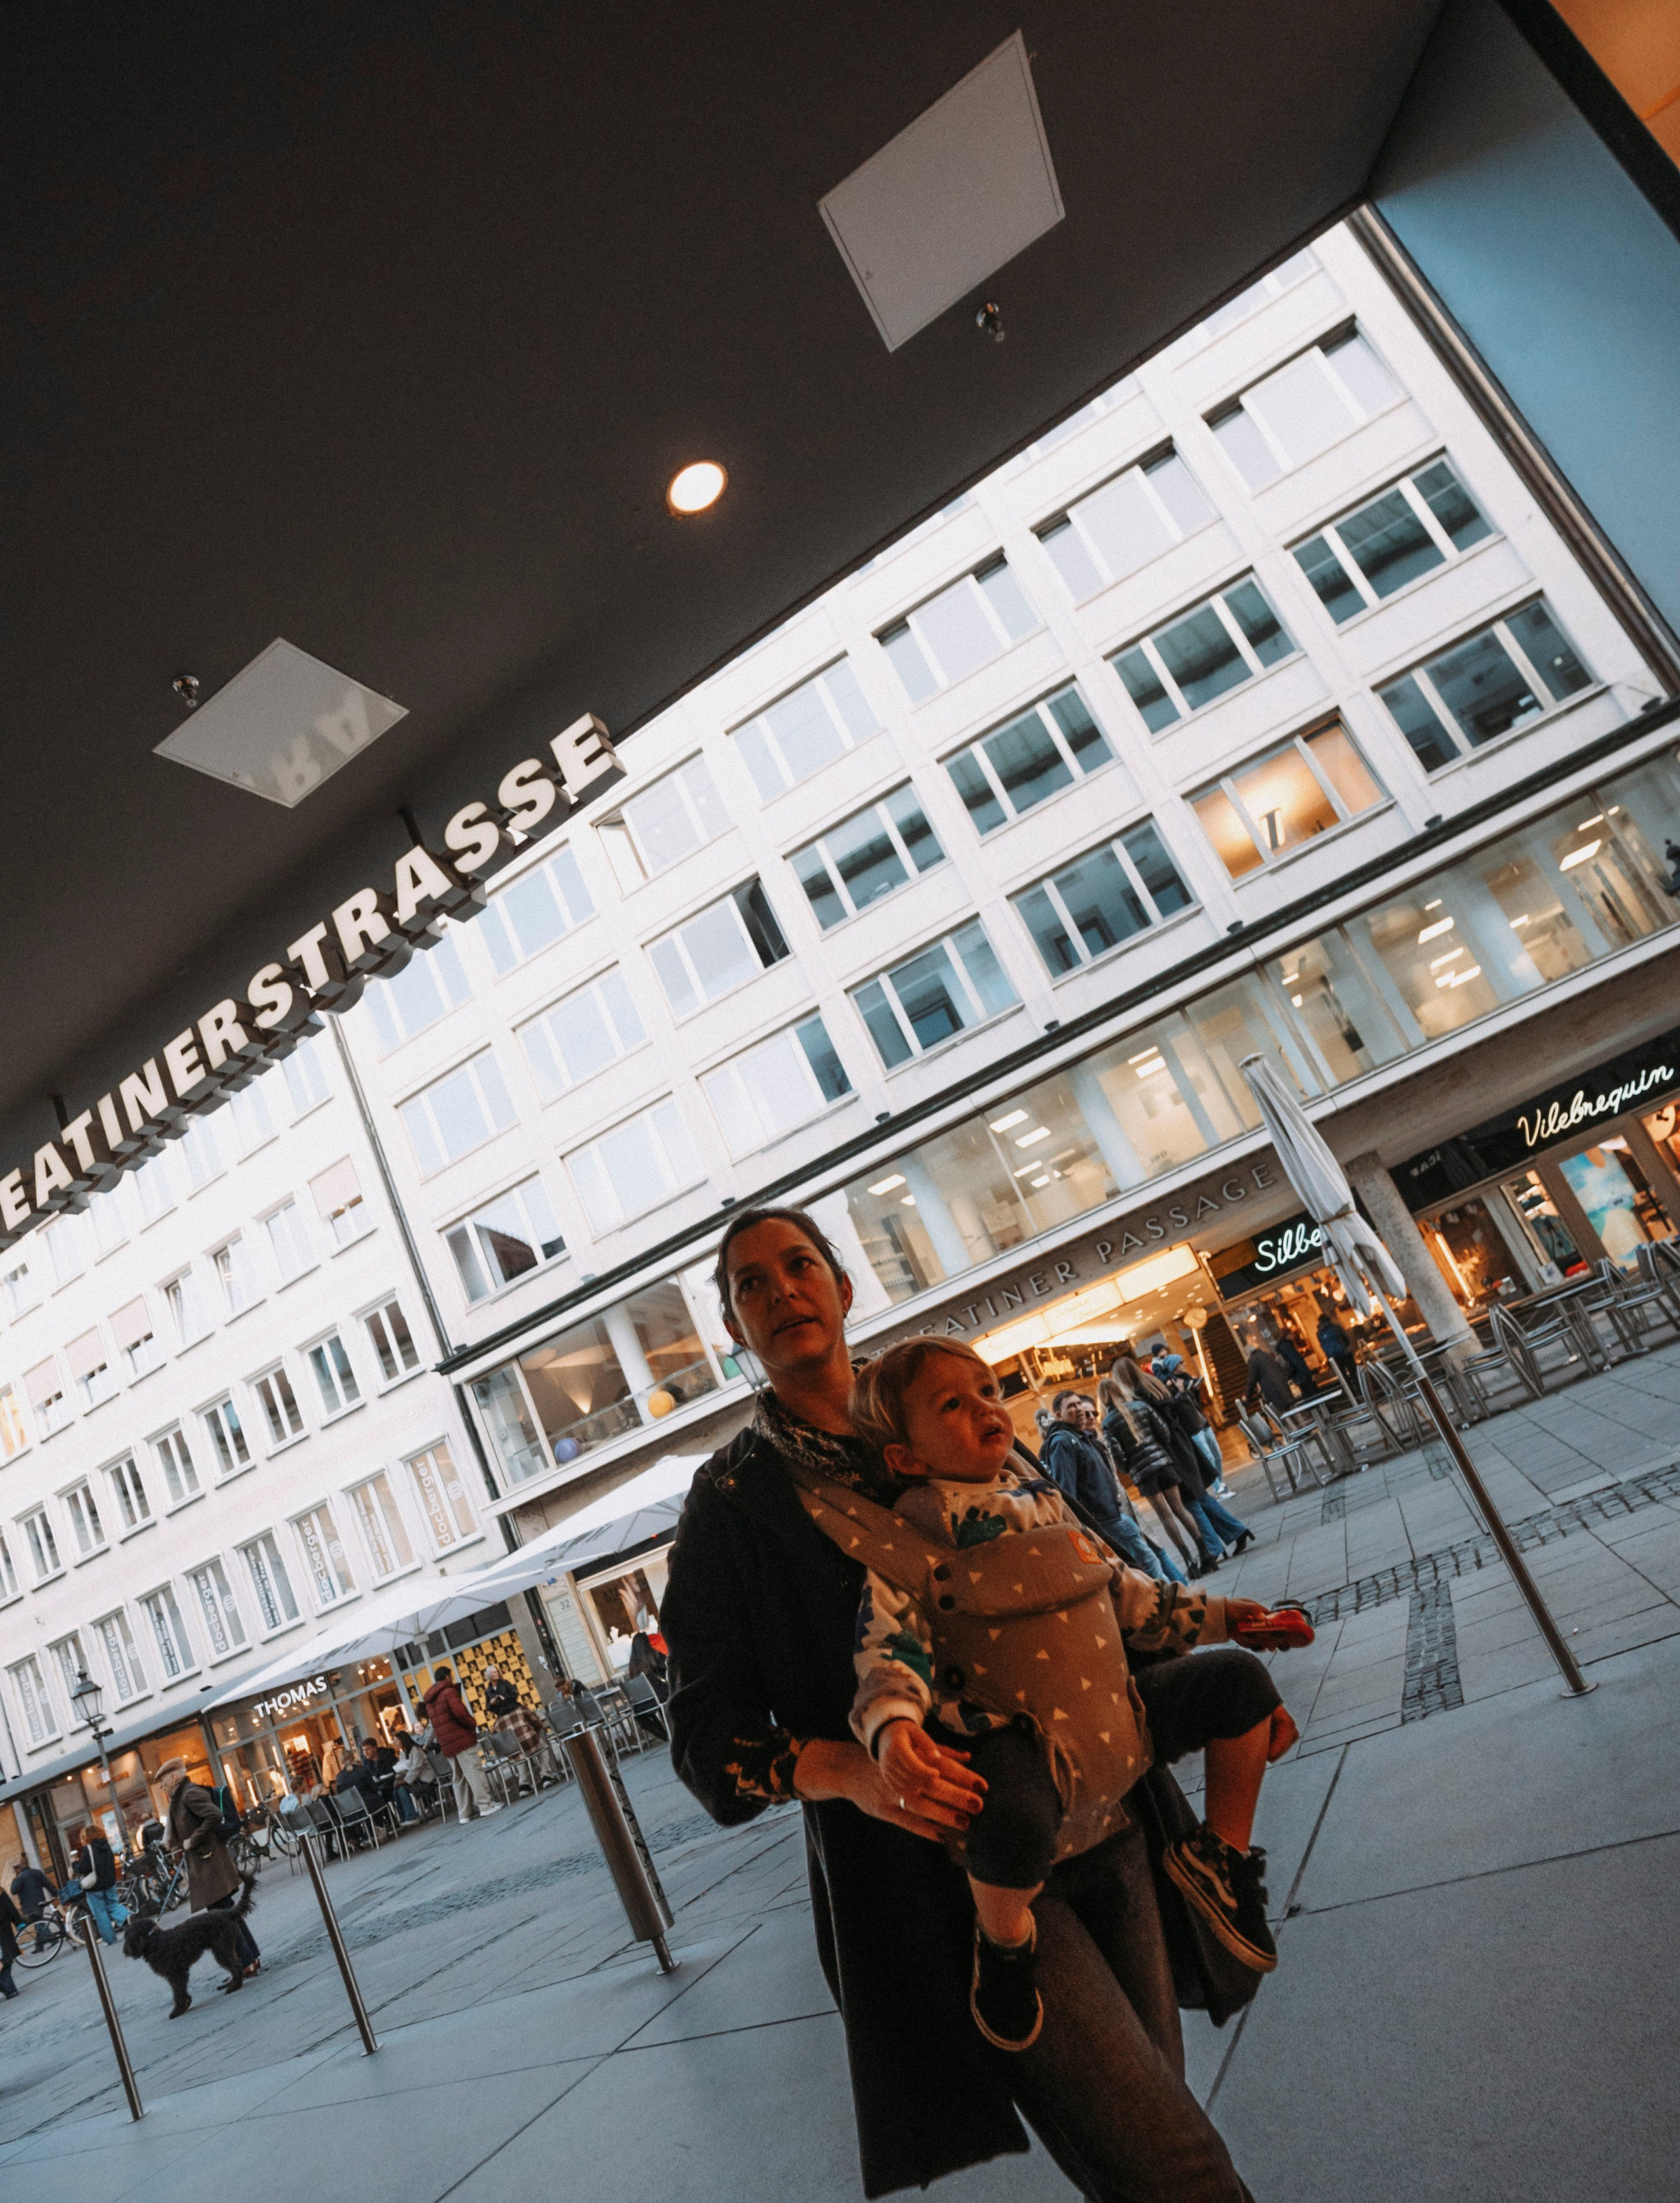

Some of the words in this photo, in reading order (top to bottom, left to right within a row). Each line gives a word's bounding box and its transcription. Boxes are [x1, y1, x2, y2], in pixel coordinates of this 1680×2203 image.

[0, 712, 614, 1232] EATINERSTRASSE
[1517, 1065, 1673, 1146] Vilebrequin
[1095, 1164, 1274, 1264] PASSAGE
[416, 1461, 452, 1544] docberger
[302, 1521, 334, 1599] docberger
[197, 1575, 226, 1651] docberger
[558, 1599, 571, 1610] 32
[104, 1624, 131, 1696] docberger
[253, 1676, 327, 1718] THOMAS
